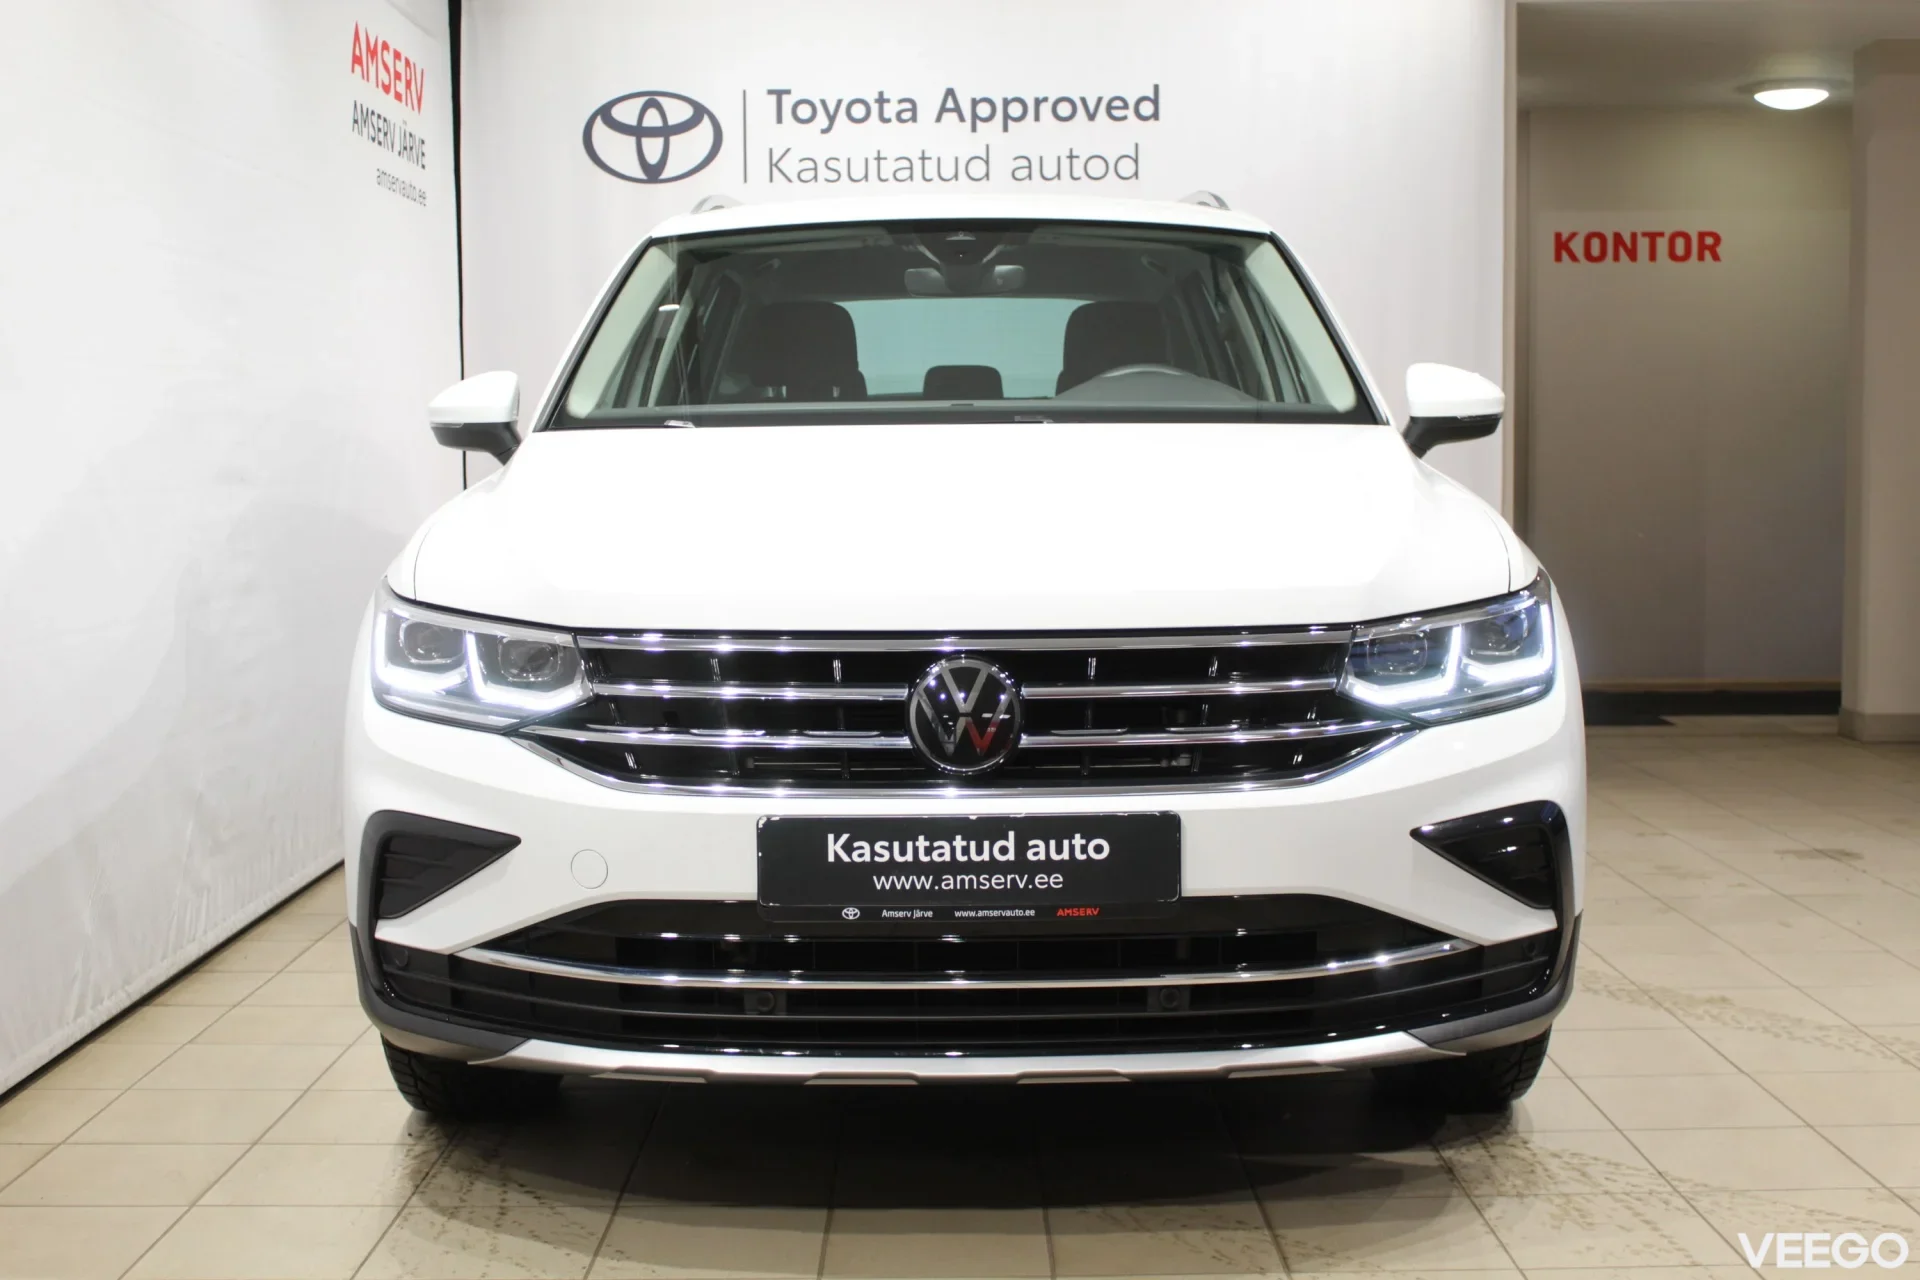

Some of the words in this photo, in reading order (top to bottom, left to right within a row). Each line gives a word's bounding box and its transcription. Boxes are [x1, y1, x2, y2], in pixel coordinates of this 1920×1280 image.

[351, 20, 424, 114] AMSERV
[766, 88, 918, 134] Toyota
[935, 84, 1160, 133] Approved
[352, 99, 396, 153] AMSERV
[397, 118, 426, 170] JÄRVE
[768, 144, 990, 183] Kasutatud
[1011, 143, 1140, 181] autod
[376, 167, 427, 207] amservauto.ee
[1554, 231, 1722, 263] KONTOR
[827, 831, 1016, 862] Kasutatud
[1026, 833, 1110, 861] auto
[873, 871, 1064, 891] www.amserv.ee
[881, 908, 912, 919] Amserv
[913, 908, 934, 919] Järve
[954, 907, 1036, 918] www.amservauto.ee
[1056, 907, 1100, 917] AMSERV
